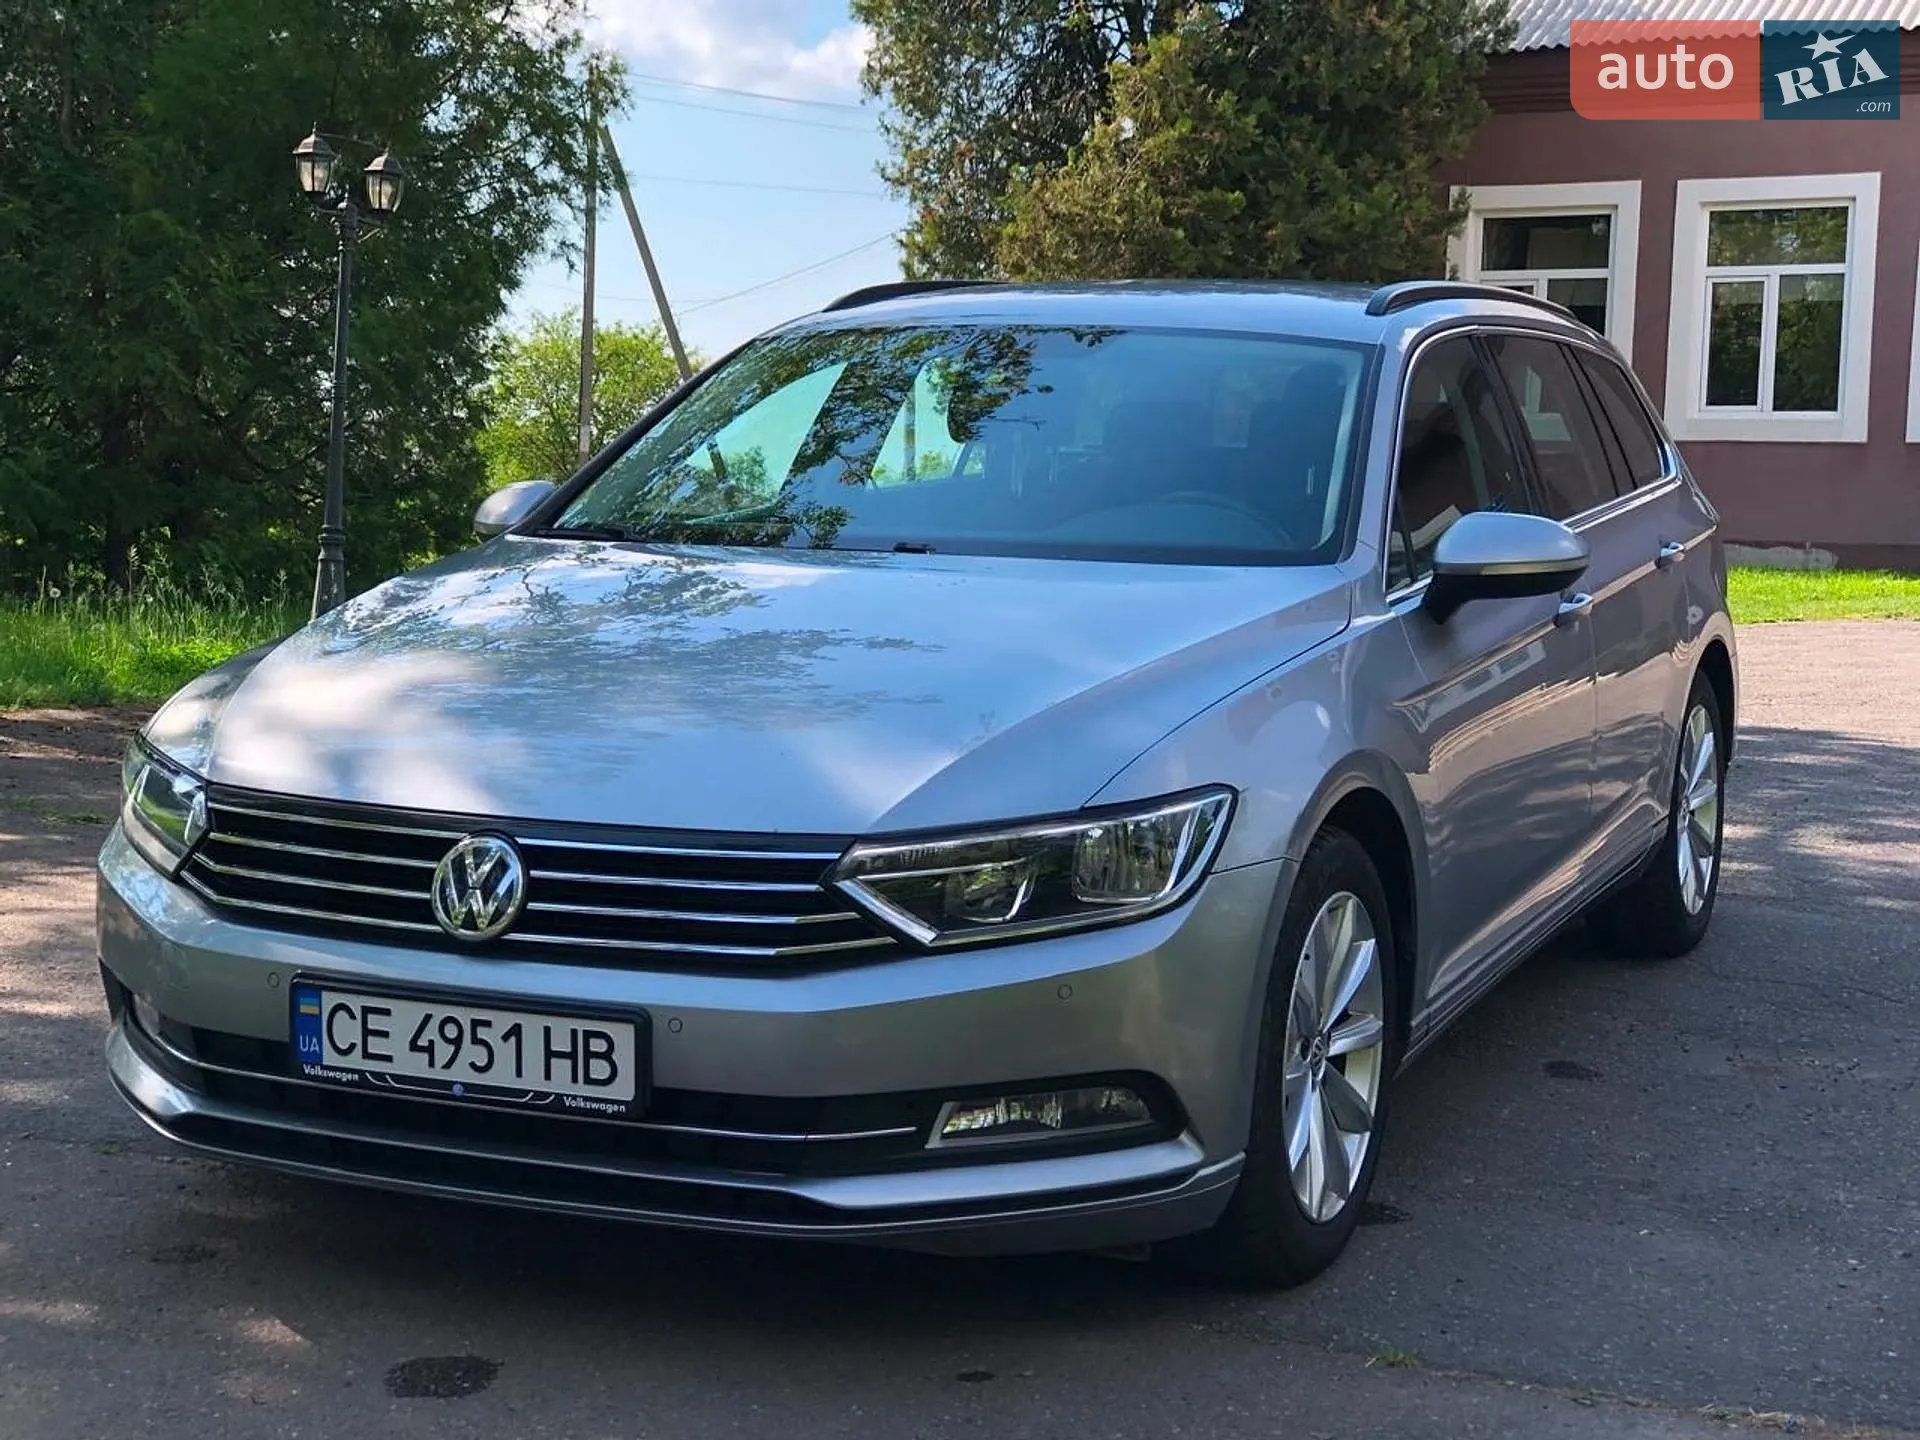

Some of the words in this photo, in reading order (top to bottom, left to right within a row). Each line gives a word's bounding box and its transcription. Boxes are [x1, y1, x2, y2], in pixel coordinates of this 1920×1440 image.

[299, 1036, 320, 1053] UA
[327, 1002, 394, 1063] CE
[409, 1012, 523, 1078] 4951
[543, 1025, 618, 1087] HB
[303, 1063, 359, 1082] Volkswagen
[563, 1095, 626, 1113] Volkswagen
